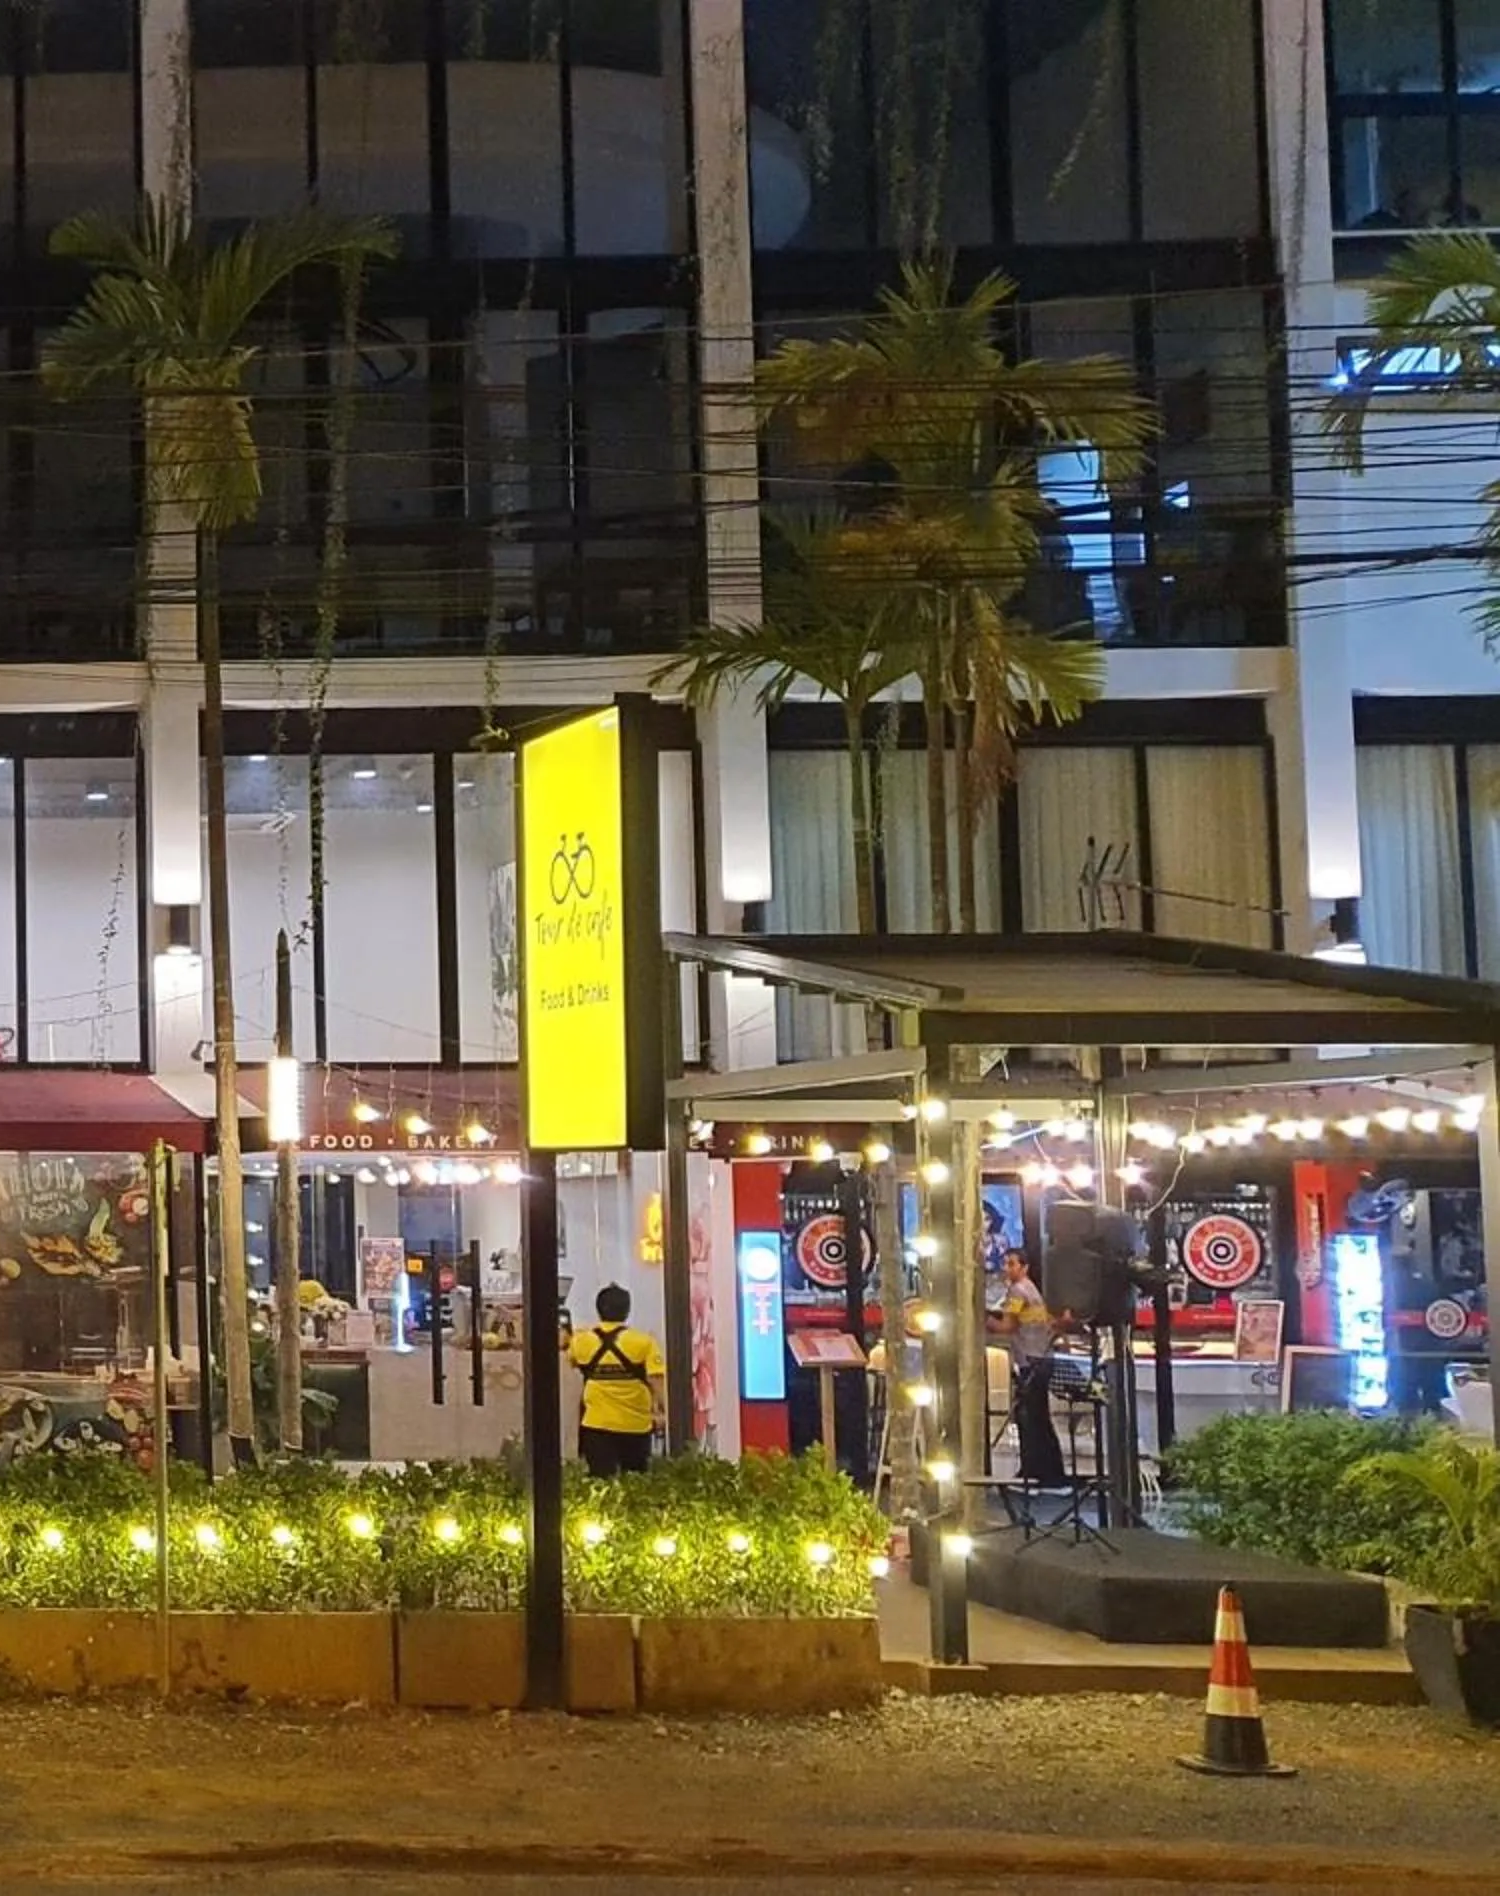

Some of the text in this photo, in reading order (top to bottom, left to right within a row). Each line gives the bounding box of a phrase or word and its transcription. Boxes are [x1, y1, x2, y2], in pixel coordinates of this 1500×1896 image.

[535, 912, 564, 945] Tour
[567, 900, 583, 944] de
[541, 981, 609, 1010] Food & Drinks
[309, 1134, 373, 1149] FOOD
[407, 1134, 498, 1149] BAKEY
